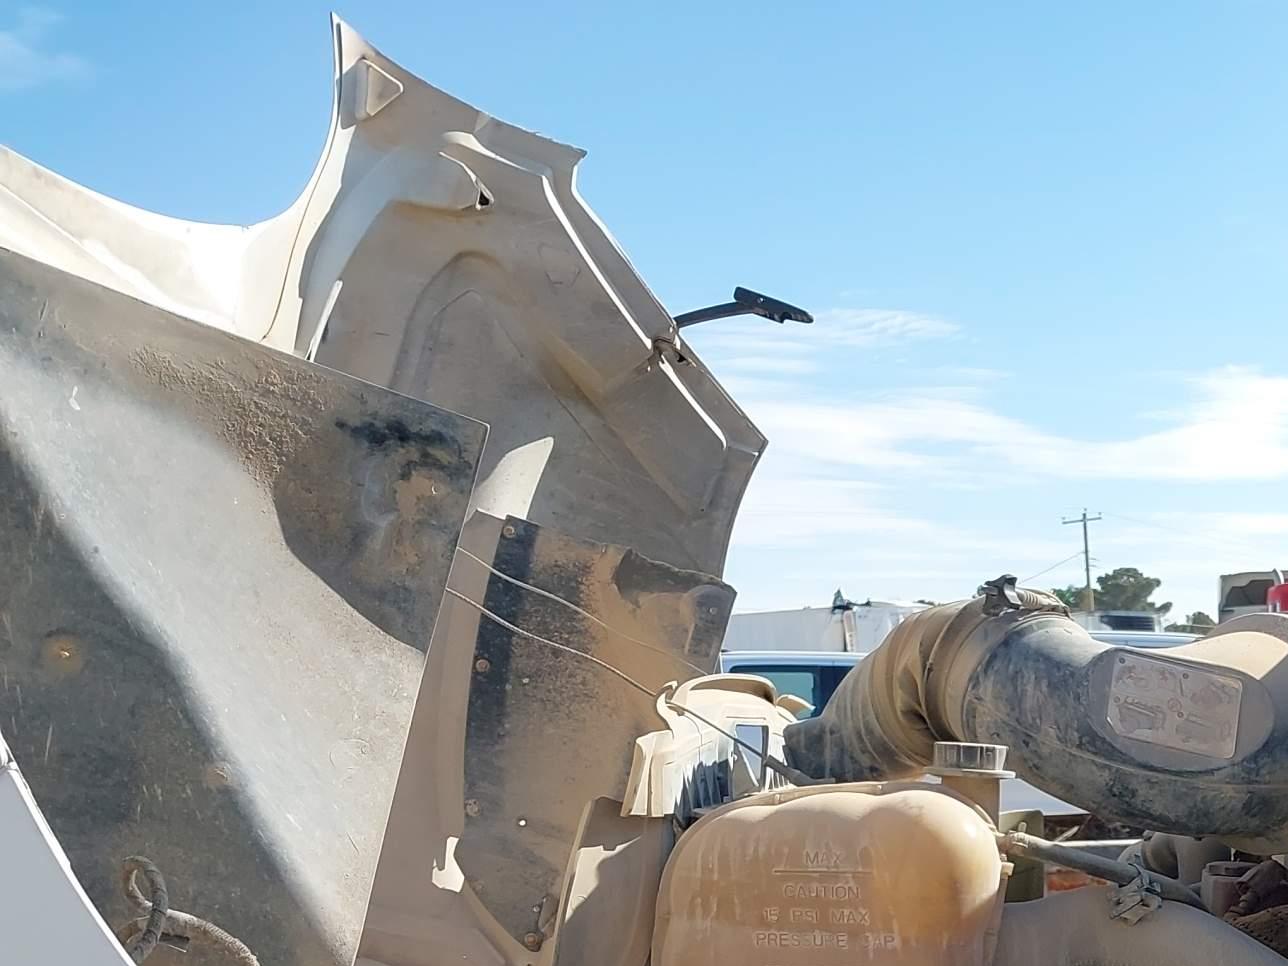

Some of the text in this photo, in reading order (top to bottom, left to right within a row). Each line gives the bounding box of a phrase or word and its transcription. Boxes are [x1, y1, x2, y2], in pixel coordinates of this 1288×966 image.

[804, 850, 842, 866] MAX
[783, 883, 862, 900] CAUTION
[763, 907, 871, 926] 15 PSI MAX
[754, 931, 849, 949] PRESSURE
